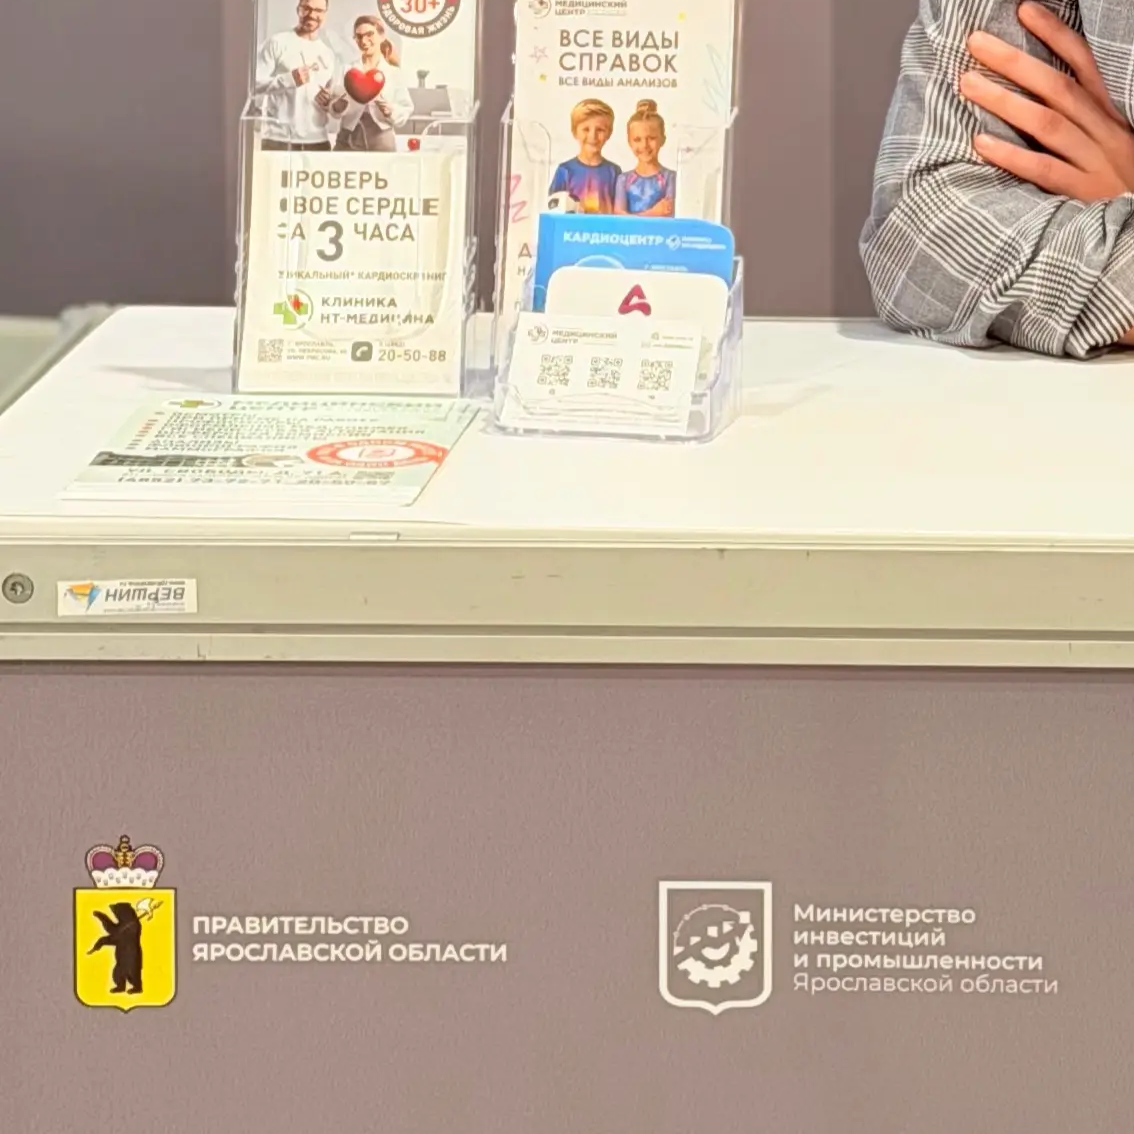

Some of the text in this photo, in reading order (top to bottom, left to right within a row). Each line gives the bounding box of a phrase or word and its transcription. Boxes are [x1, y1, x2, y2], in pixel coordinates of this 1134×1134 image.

[555, 0, 628, 9] МЕДИЦИНСКИЙ
[555, 8, 586, 16] ЦЕНТР
[559, 29, 679, 51] ВСЕ ВИДЫ
[558, 52, 678, 73] СПРАВОК
[558, 76, 678, 88] ВСЕ ВИДЫ АНАЛИЗОВ
[316, 220, 344, 262] 3
[353, 223, 415, 242] ЧАСА
[563, 231, 664, 248] КАРДИОЦЕНТР
[321, 297, 398, 308] КЛИНИКА
[378, 349, 447, 362] 20-50-88
[192, 916, 409, 936] ПРАВИТЕЛЬСТВО
[793, 904, 976, 928] Министерство
[793, 928, 946, 949] инвестиций
[192, 940, 507, 963] ЯРОСЛАВСКОЙ ОБЛАСТИ
[793, 954, 1043, 973] и промышленности
[793, 974, 1059, 995] Ярославской области
